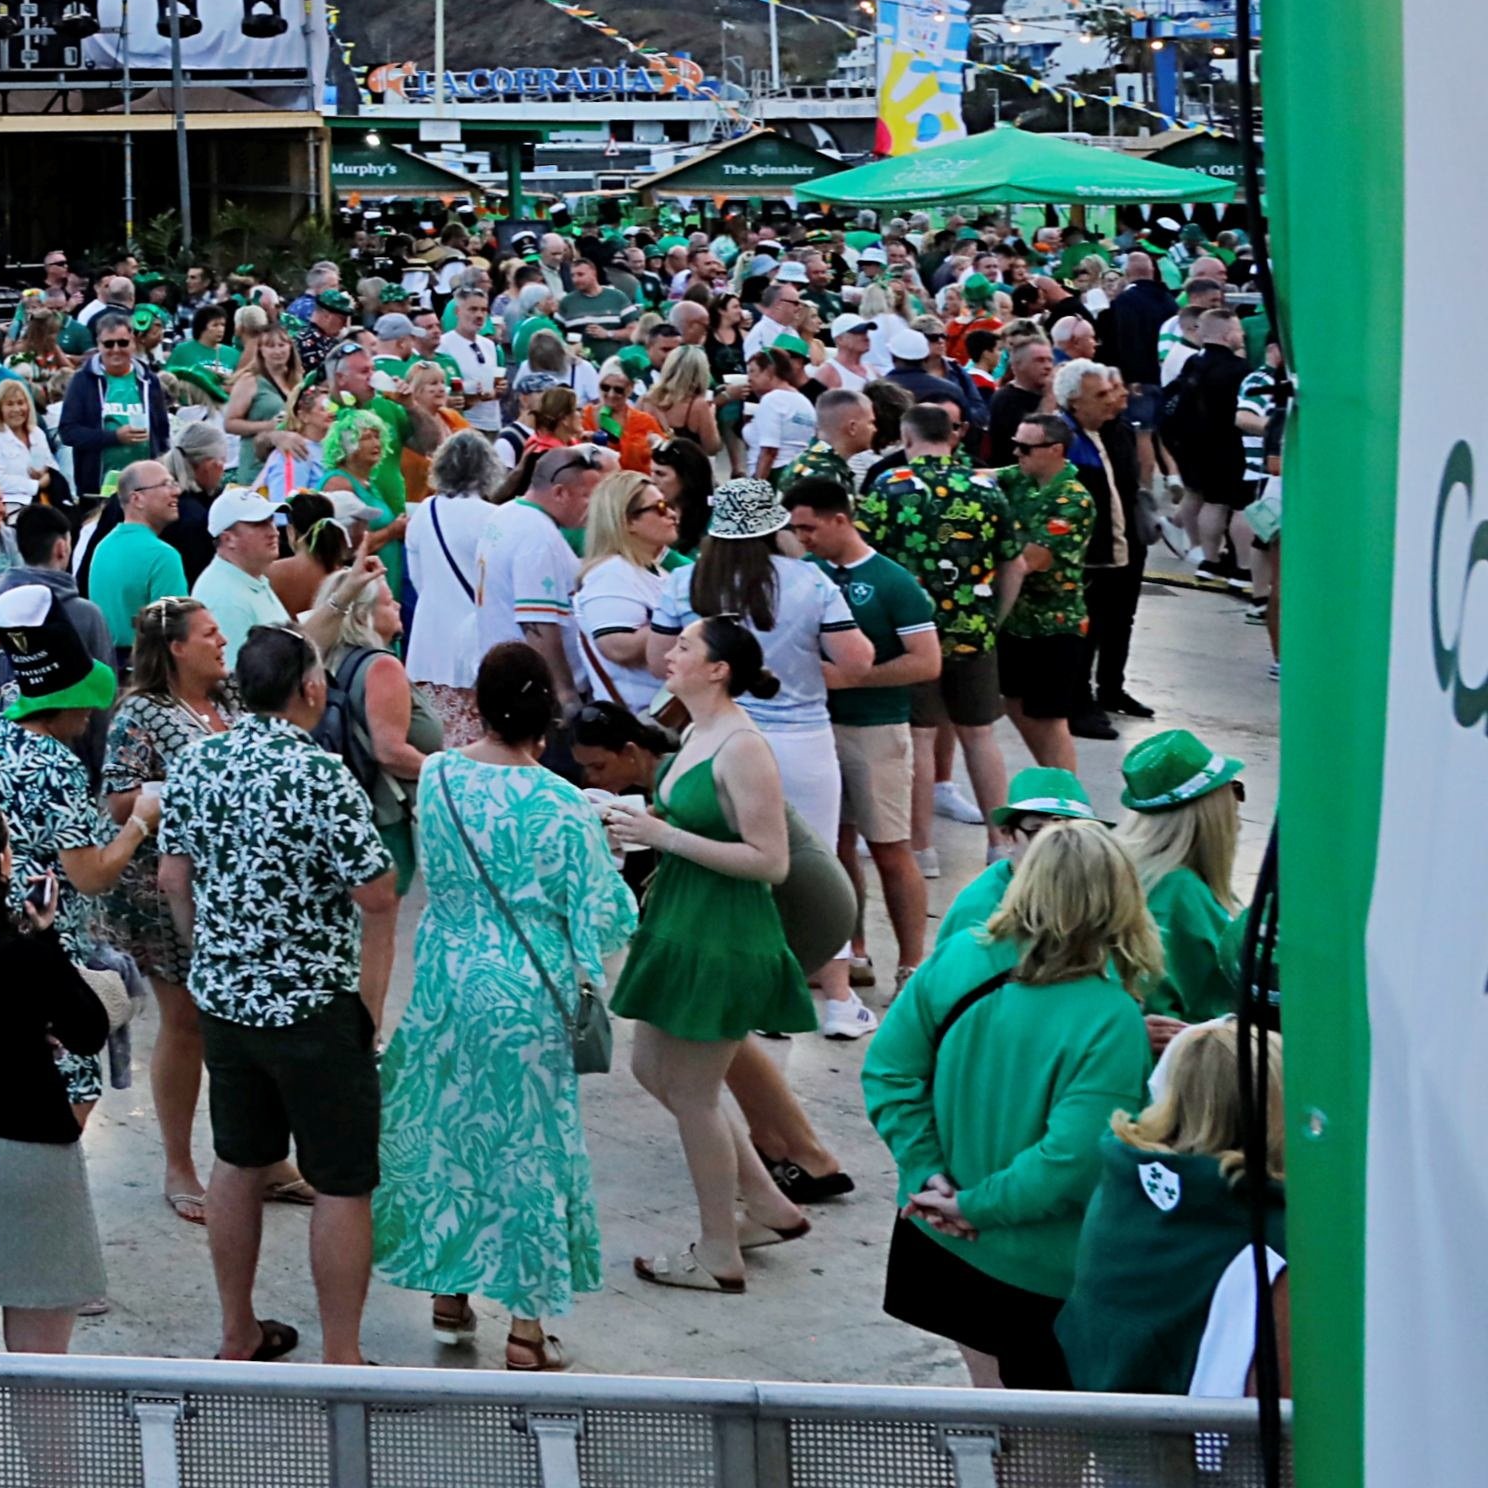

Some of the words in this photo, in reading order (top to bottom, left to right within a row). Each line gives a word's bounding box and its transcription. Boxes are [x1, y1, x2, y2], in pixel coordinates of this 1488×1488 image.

[467, 59, 656, 95] COFRADÍA
[331, 162, 398, 177] Murphy's
[723, 164, 749, 175] The
[750, 164, 815, 176] Spinnaker
[1209, 165, 1235, 176] Old
